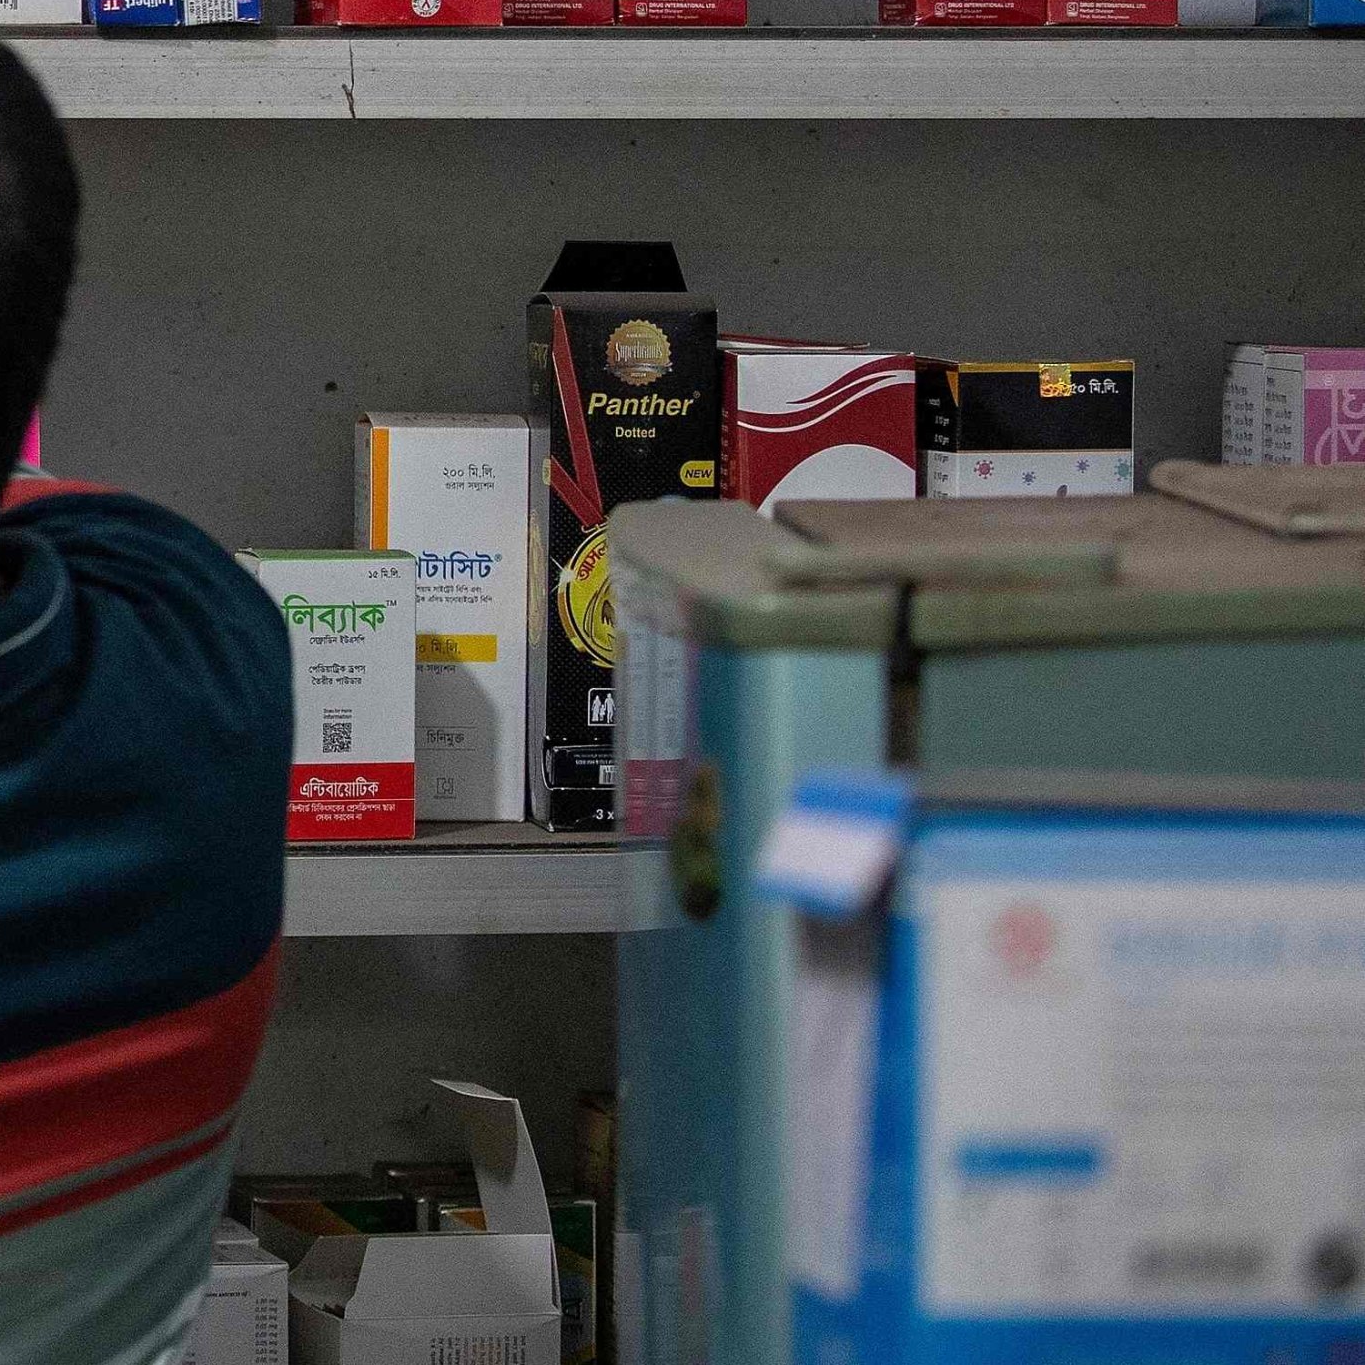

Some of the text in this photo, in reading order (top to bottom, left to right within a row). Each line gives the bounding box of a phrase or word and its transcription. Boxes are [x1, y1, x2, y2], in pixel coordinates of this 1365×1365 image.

[588, 392, 693, 416] Panther
[615, 426, 656, 438] Dotted
[685, 468, 712, 479] NEW
